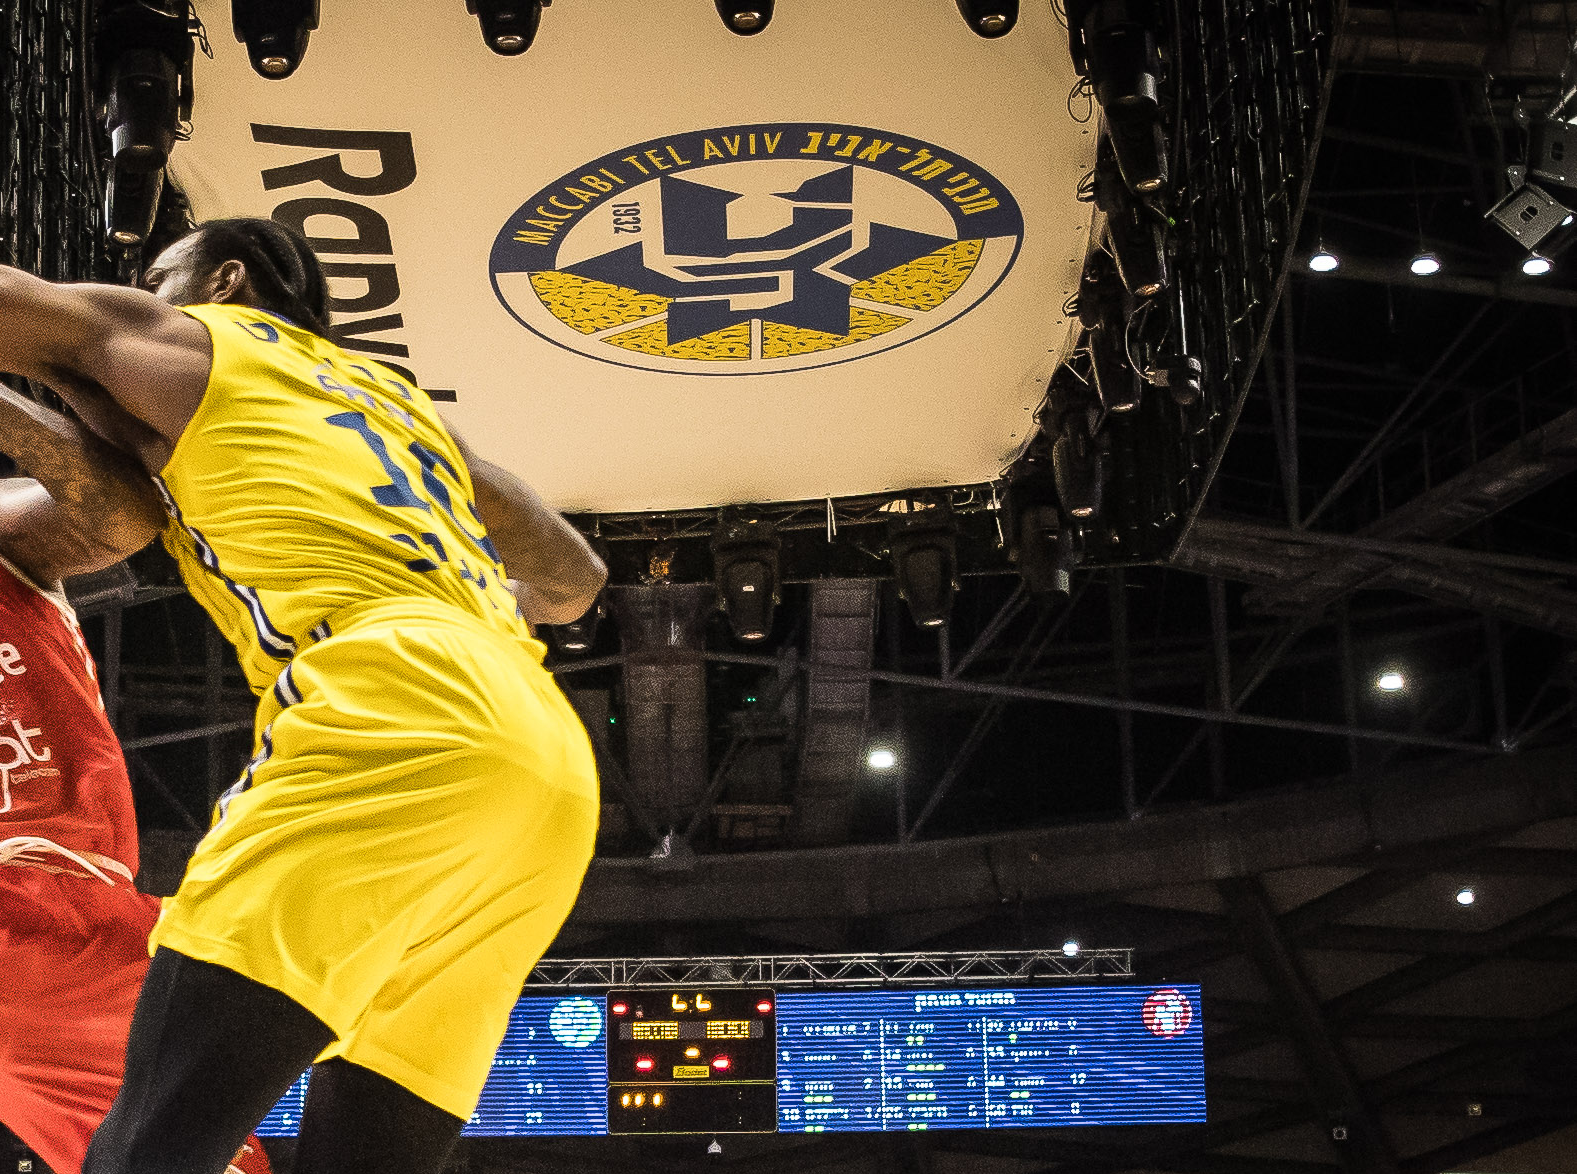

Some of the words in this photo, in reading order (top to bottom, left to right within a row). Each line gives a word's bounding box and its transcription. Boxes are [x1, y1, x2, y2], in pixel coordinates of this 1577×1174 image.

[513, 167, 625, 247] MACCABI
[621, 143, 691, 176] TEL
[703, 131, 783, 161] AVIV
[611, 201, 642, 235] 1932
